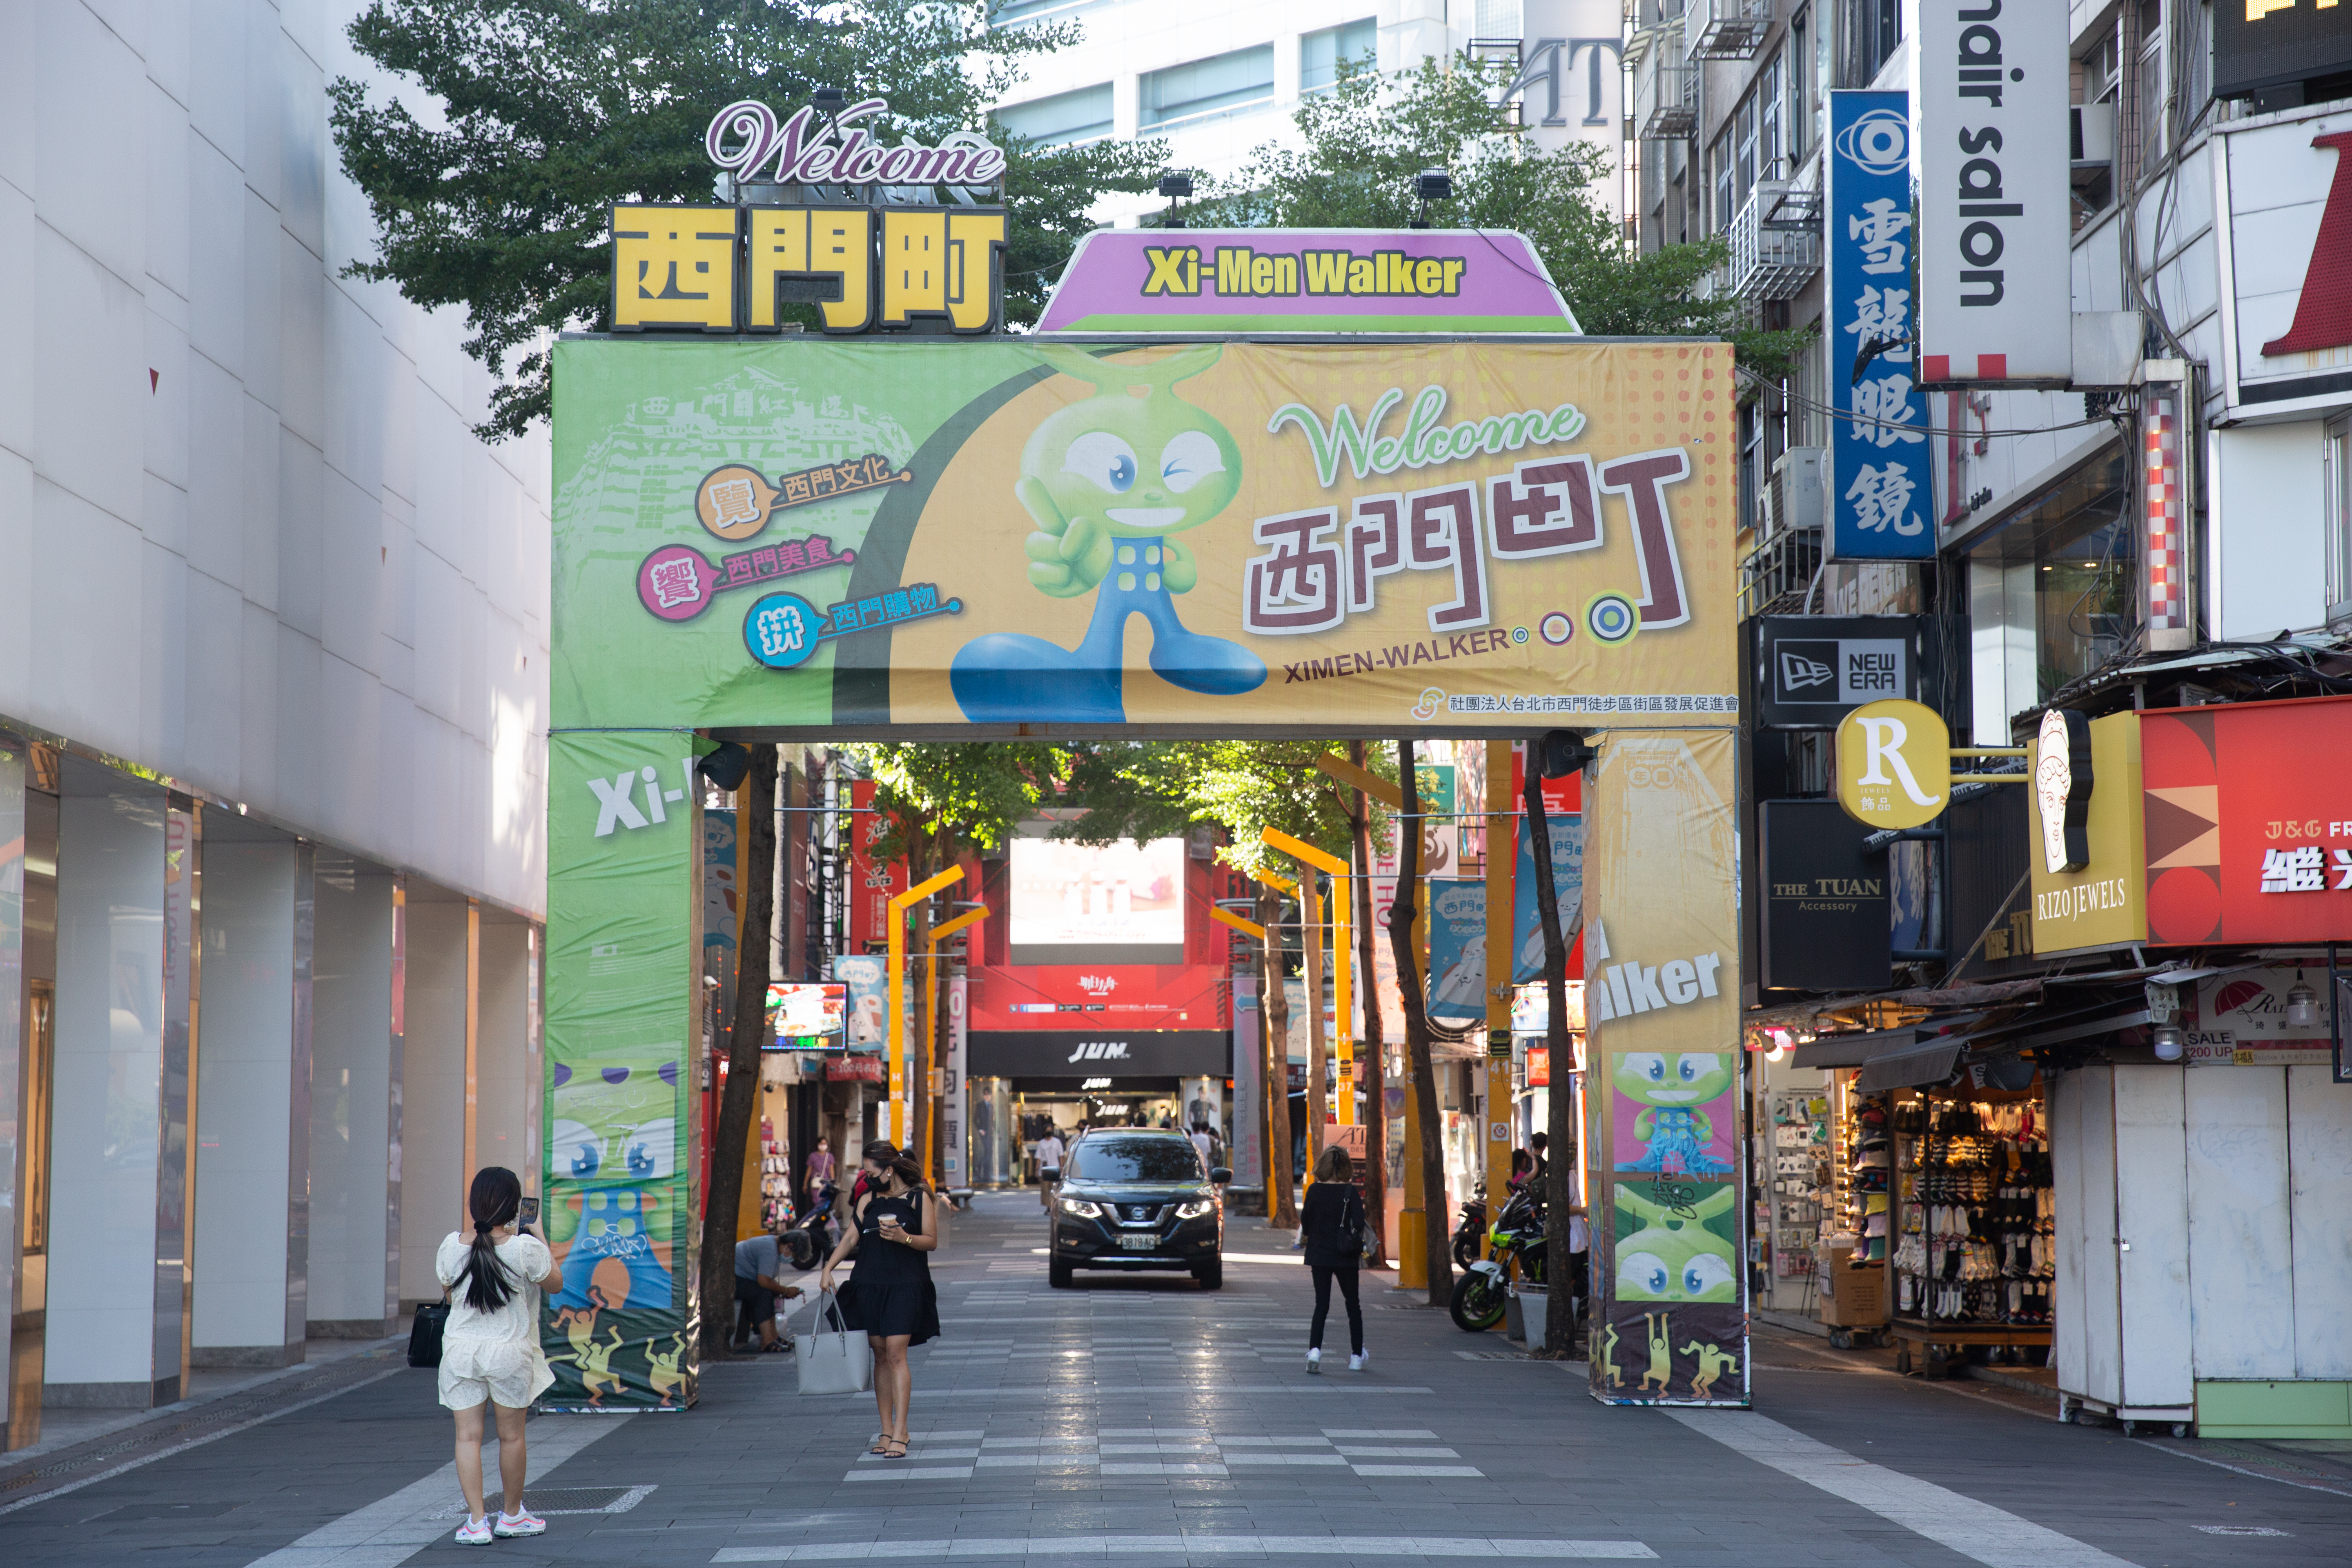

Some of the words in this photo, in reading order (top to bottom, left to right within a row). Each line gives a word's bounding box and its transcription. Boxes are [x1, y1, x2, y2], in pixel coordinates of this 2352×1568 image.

[706, 98, 1007, 185] Welcome
[1959, 126, 2024, 307] salon
[610, 203, 1009, 333] 西門町
[1143, 247, 1300, 297] Xi-Men
[1304, 249, 1466, 298] Walker
[1844, 198, 1926, 536] 雪龍眼鏡
[1267, 385, 1586, 488] Welcome
[711, 480, 758, 527] 覽
[783, 457, 889, 501] 西門文化
[1243, 448, 1690, 635] 西門町
[653, 559, 699, 606] 饗
[725, 536, 831, 582] 西門美食
[760, 608, 803, 653] 拼
[831, 586, 937, 630] 西門購物
[1284, 629, 1510, 684] XIMEN-WALKER
[1849, 653, 1895, 672] NEW
[1849, 673, 1895, 690] ERA
[1450, 695, 1739, 714] 社團法人台北市西門徒步區街區發展促進會
[1855, 717, 1940, 806] R
[1860, 797, 1891, 811] 飾品
[2265, 820, 2322, 839] J&G
[1773, 884, 1808, 895] THE
[1815, 879, 1881, 895] TUAN
[1798, 901, 1857, 912] Accessory
[2038, 889, 2070, 921] RIZO
[2072, 878, 2125, 922] JEWELS
[2187, 1033, 2231, 1044] SALE
[1067, 1042, 1128, 1064] JUN
[2190, 1047, 2211, 1058] 200
[2215, 1047, 2233, 1057] UP
[1490, 1059, 1510, 1075] 41
[892, 1072, 901, 1082] H
[1082, 1078, 1111, 1090] JUN
[1407, 1072, 1414, 1083] 3
[890, 1091, 903, 1100] 30
[1339, 1082, 1352, 1092] 37
[1095, 1105, 1129, 1117] JUN
